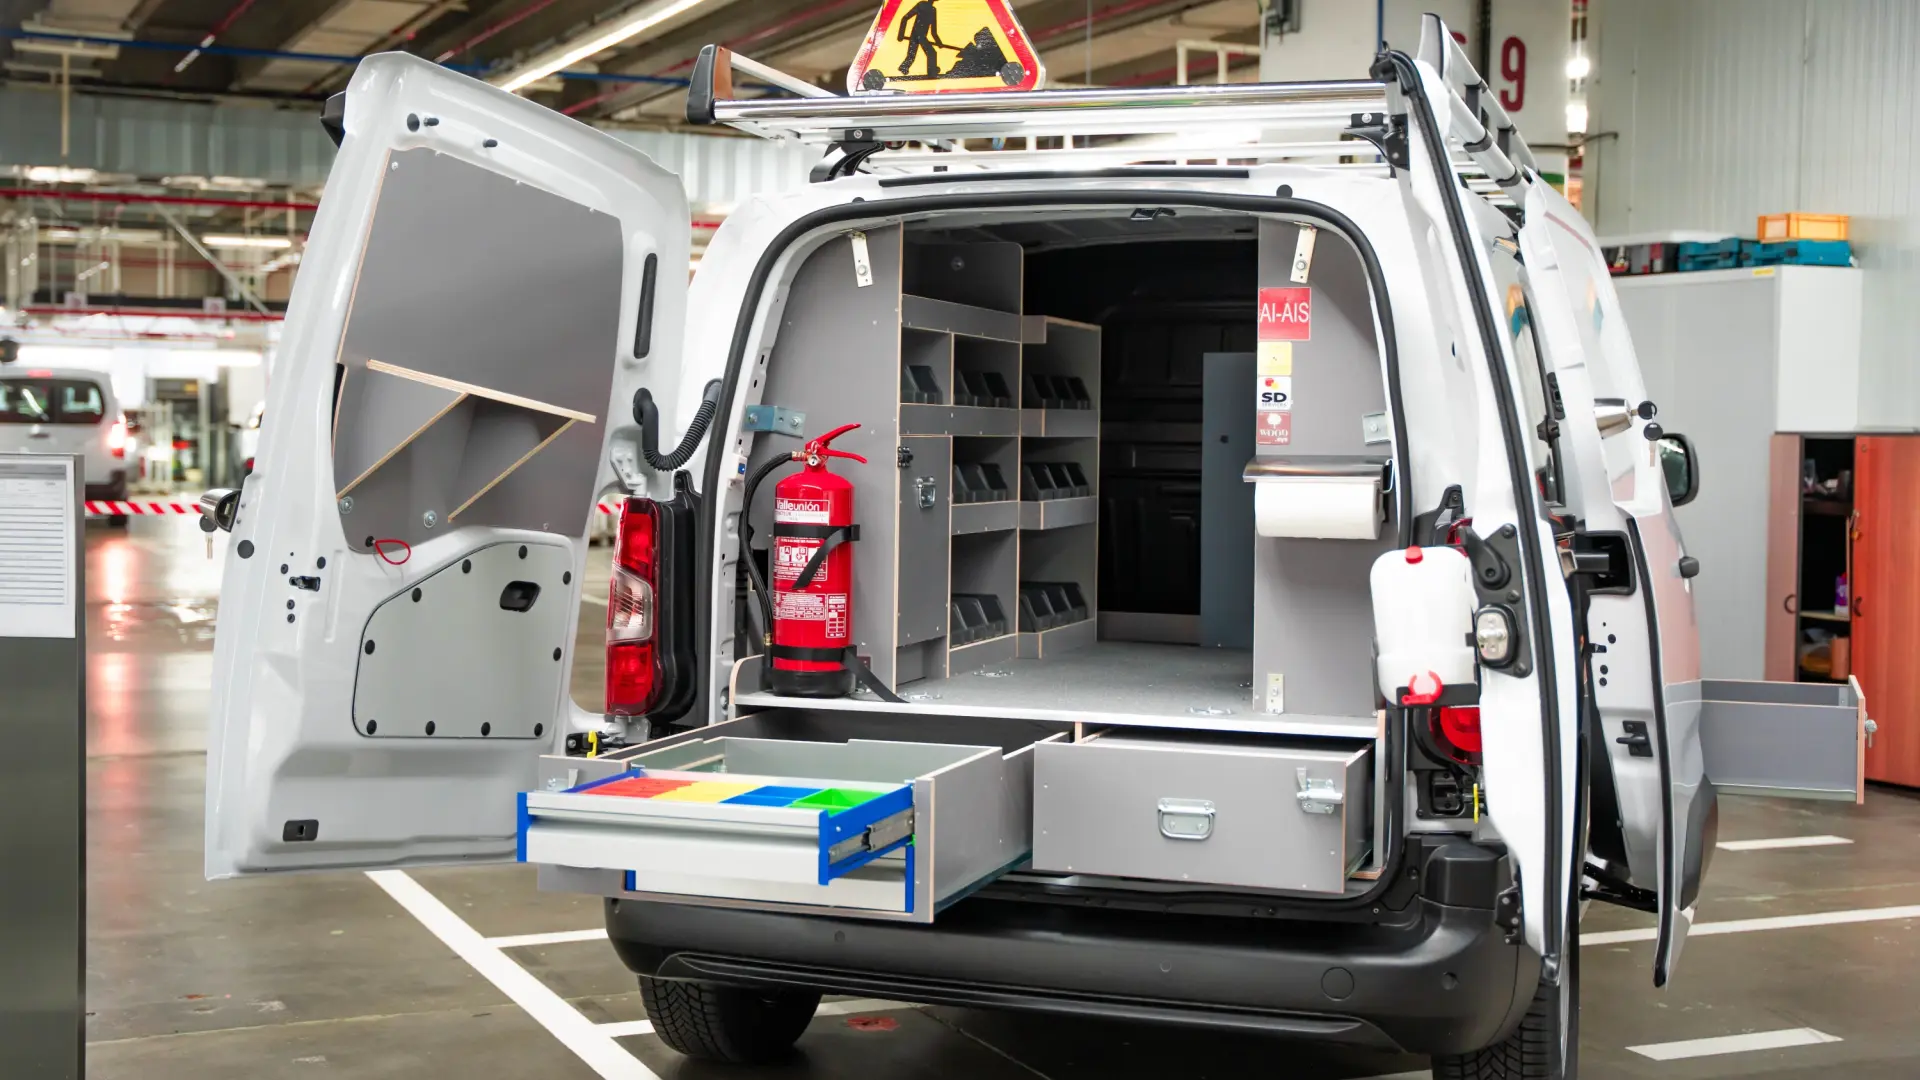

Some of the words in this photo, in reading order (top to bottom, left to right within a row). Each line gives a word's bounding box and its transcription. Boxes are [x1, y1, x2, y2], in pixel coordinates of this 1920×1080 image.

[1500, 35, 1526, 112] 9
[1259, 302, 1309, 323] AI-AIS
[1261, 392, 1287, 403] SD
[776, 499, 820, 511] Valleunión
